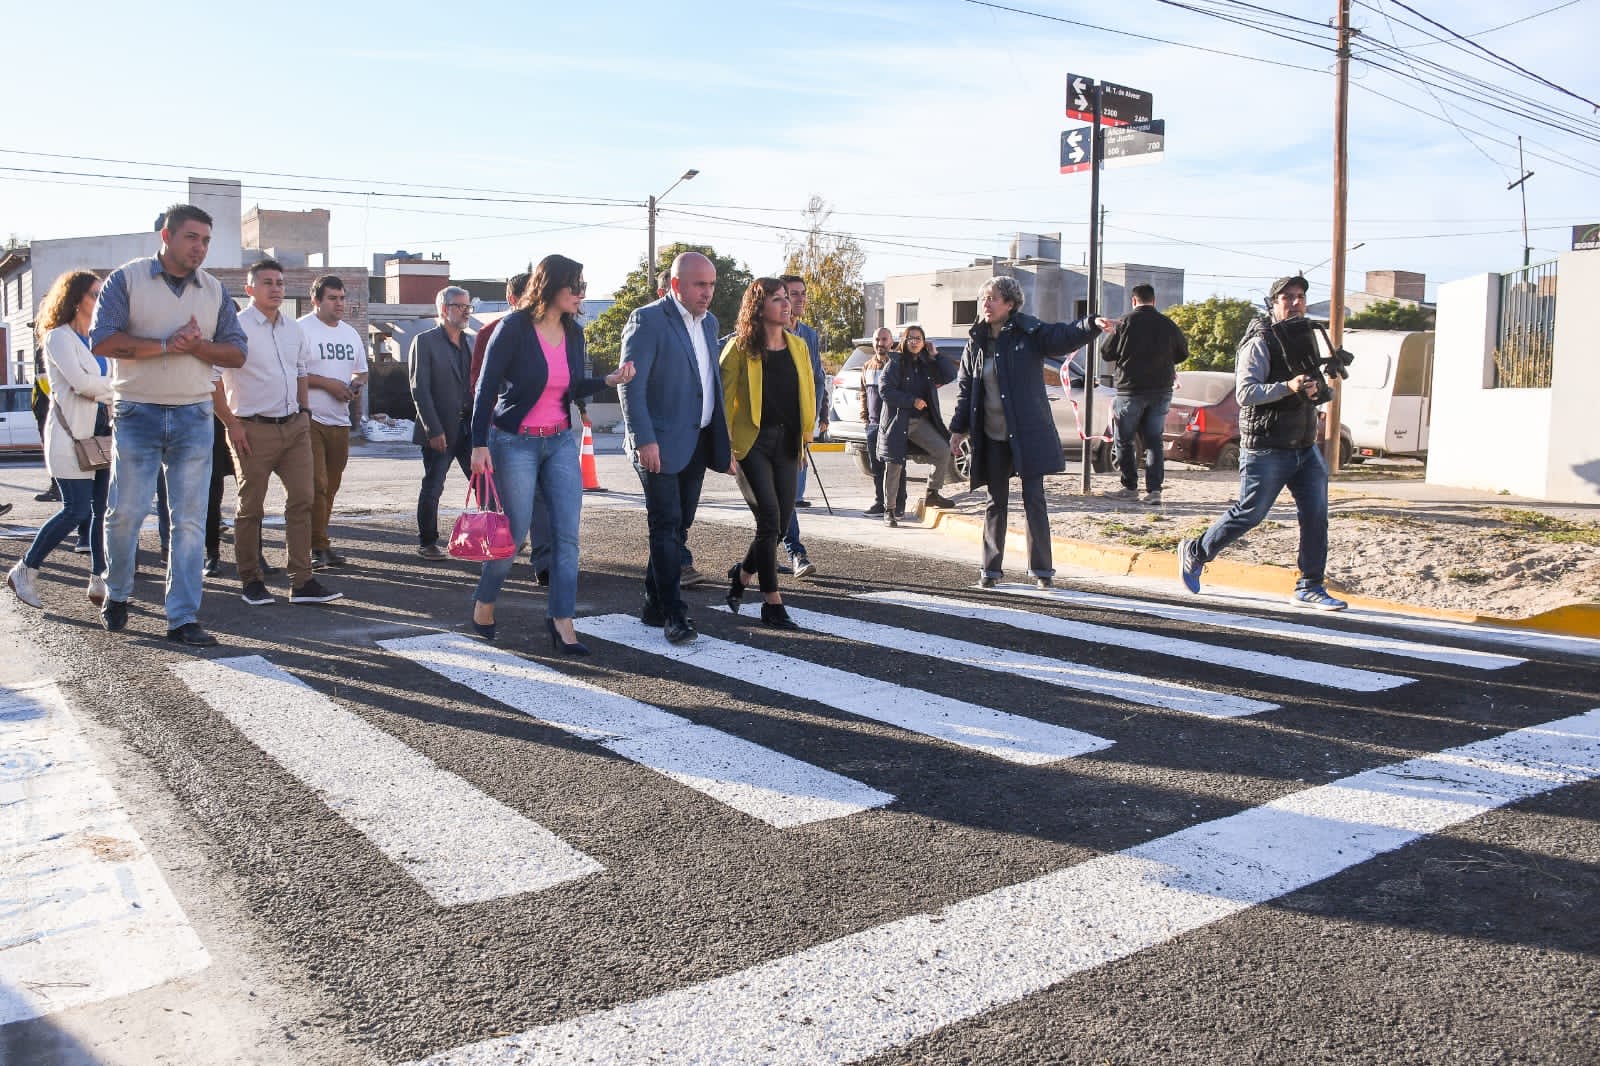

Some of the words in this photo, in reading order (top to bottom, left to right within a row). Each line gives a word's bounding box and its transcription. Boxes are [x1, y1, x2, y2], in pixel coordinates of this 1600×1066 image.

[1103, 107, 1118, 117] 2300
[1146, 141, 1160, 151] 700
[318, 342, 355, 361] 1982
